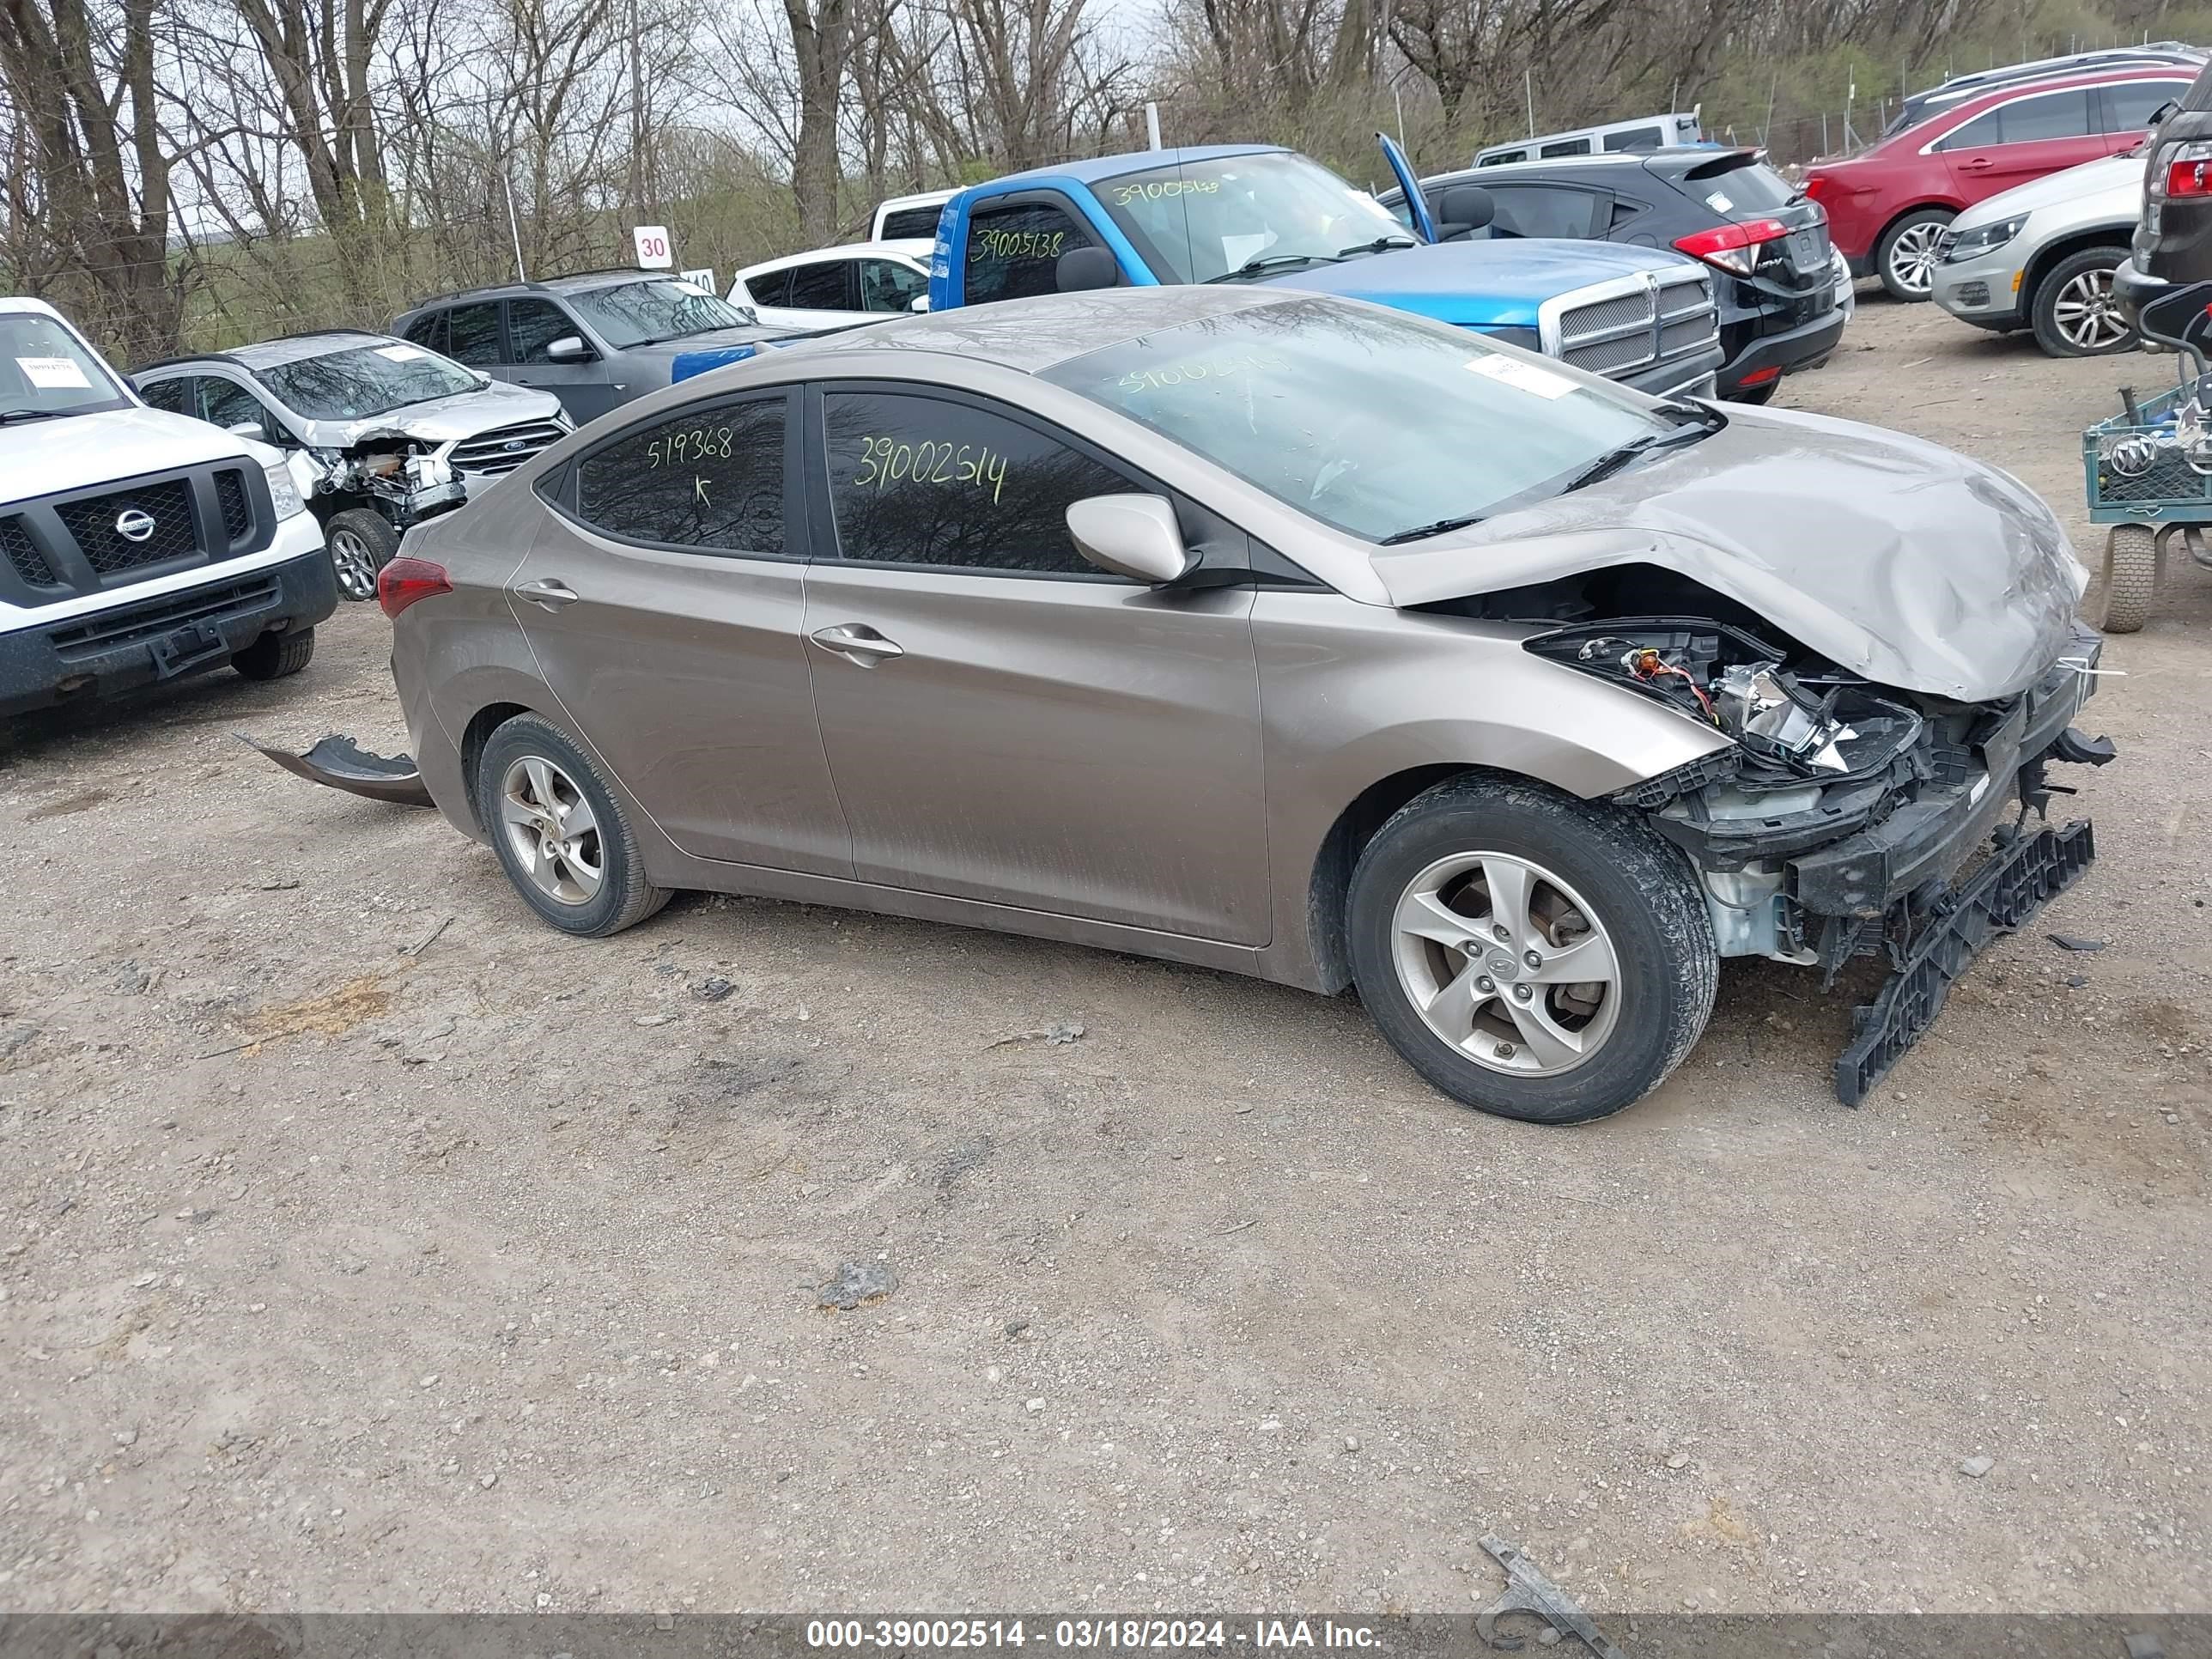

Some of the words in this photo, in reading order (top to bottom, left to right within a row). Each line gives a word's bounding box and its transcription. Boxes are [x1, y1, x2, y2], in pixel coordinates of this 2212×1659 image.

[641, 238, 665, 258] 30
[970, 229, 1065, 262] 39005138
[647, 428, 733, 469] 519368
[854, 436, 1008, 506] 39002514
